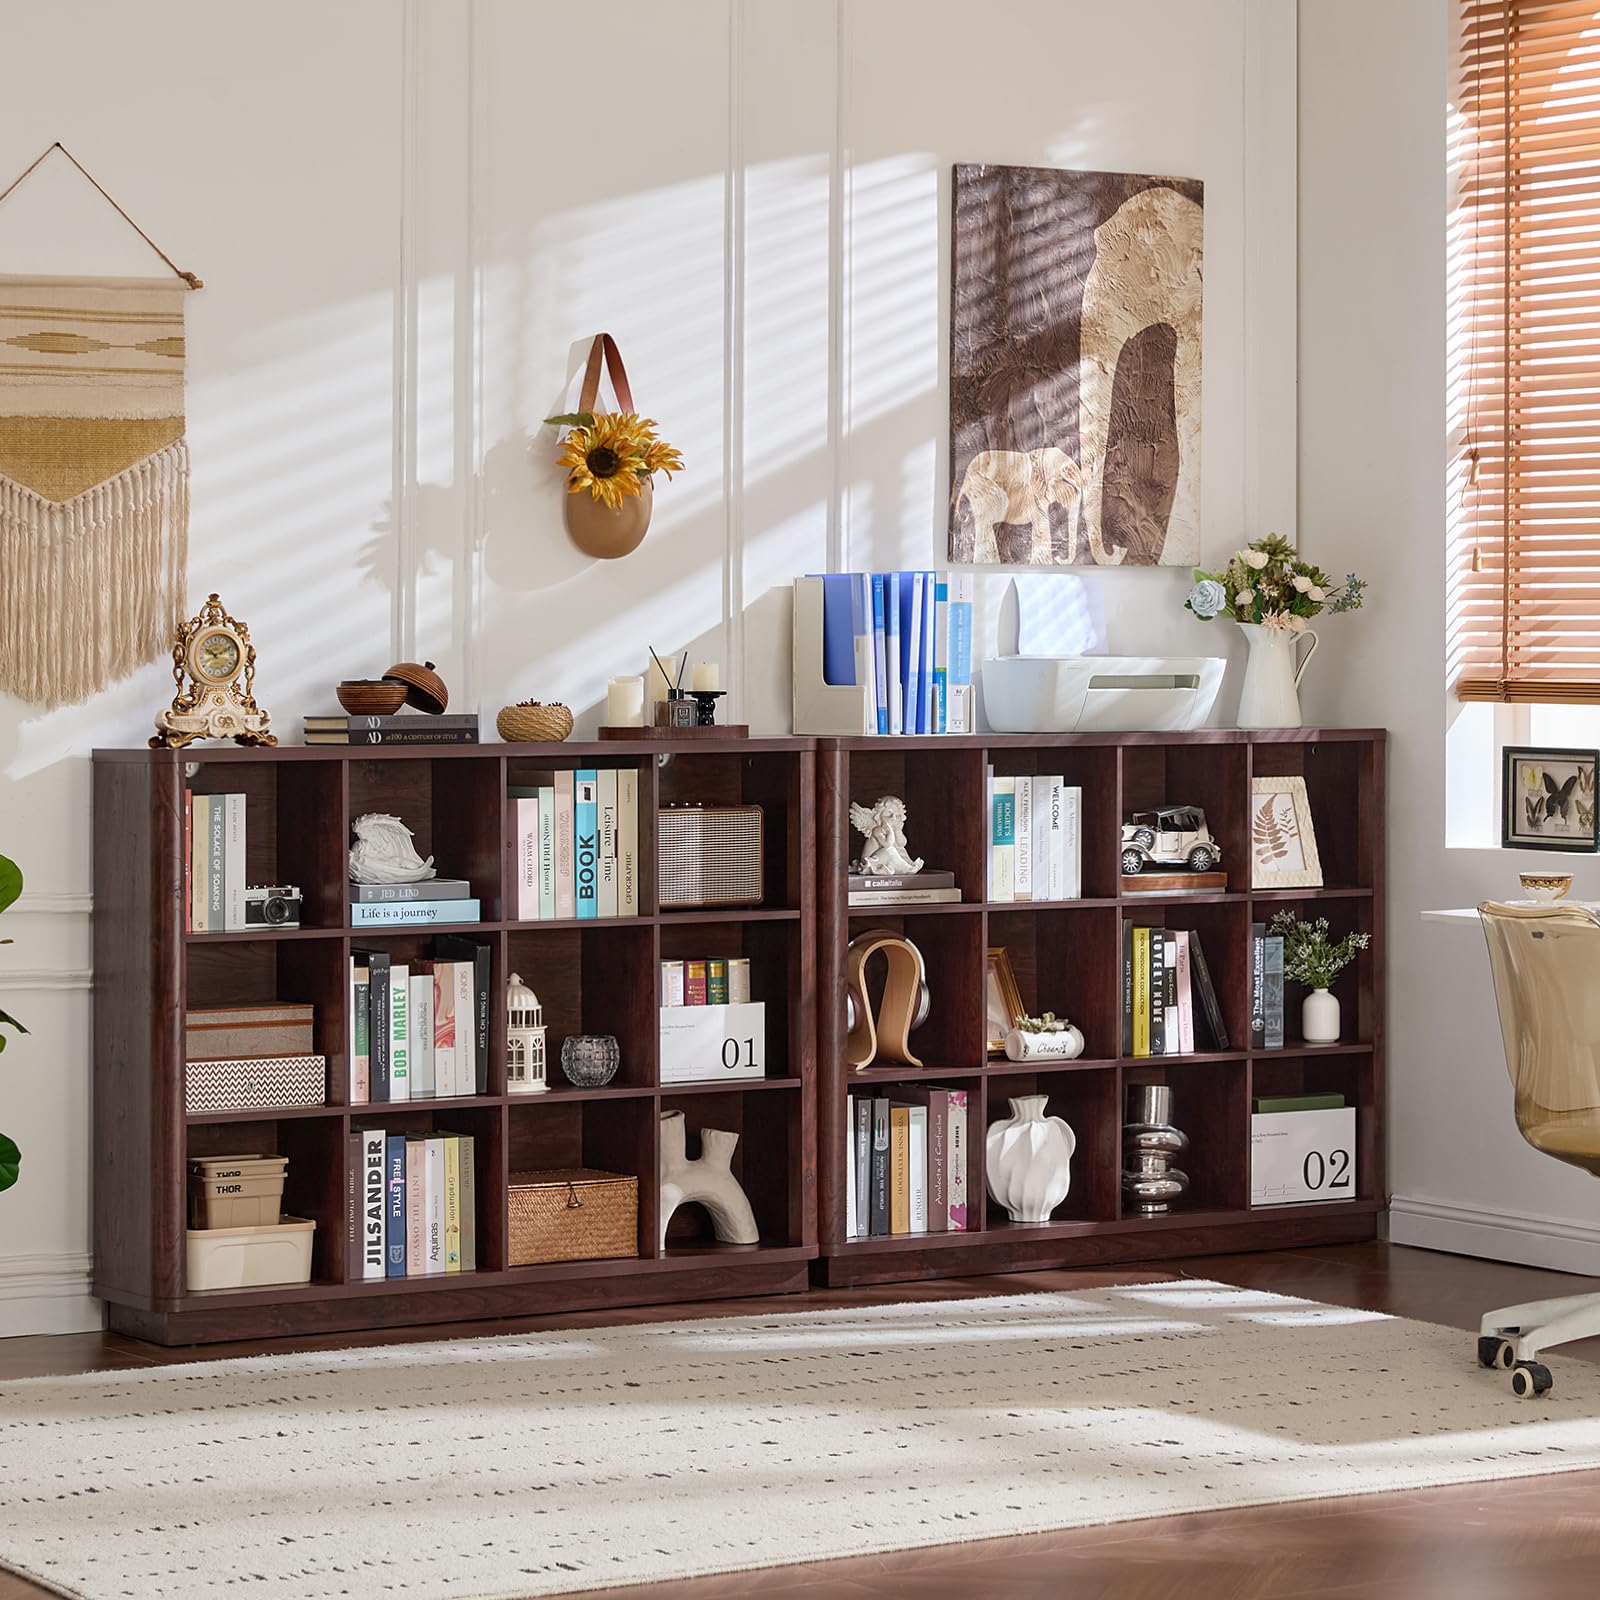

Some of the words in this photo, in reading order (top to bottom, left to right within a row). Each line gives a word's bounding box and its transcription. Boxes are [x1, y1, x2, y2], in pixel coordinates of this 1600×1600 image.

[366, 716, 381, 729] AD
[366, 731, 382, 744] AD
[213, 806, 221, 822] THE
[604, 806, 614, 847] Leisure
[213, 825, 221, 856] SOLACE
[213, 860, 221, 870] OF
[579, 835, 594, 899] BOOK
[604, 852, 614, 882] Time
[1020, 837, 1028, 884] LEADING
[213, 874, 221, 911] SOAKING
[380, 890, 395, 899] JED
[400, 889, 419, 898] LIND
[362, 908, 380, 919] Life
[383, 908, 391, 918] is
[400, 908, 438, 920] journey
[1154, 935, 1162, 989] LOVELY
[481, 992, 487, 1000] LO
[1126, 1005, 1131, 1014] LO
[1154, 992, 1162, 1023] HOME
[393, 987, 406, 1041] MARLEY
[394, 1049, 407, 1078] BOB
[722, 1038, 758, 1069] 01
[936, 1114, 945, 1155] Confucius
[937, 1158, 943, 1166] of
[1304, 1149, 1350, 1190] 02
[216, 1185, 242, 1194] THOR
[367, 1139, 382, 1266] JILSANDER
[393, 1187, 401, 1217] STYLE
[448, 1177, 456, 1221] Graduation
[430, 1222, 440, 1262] Aquinas
